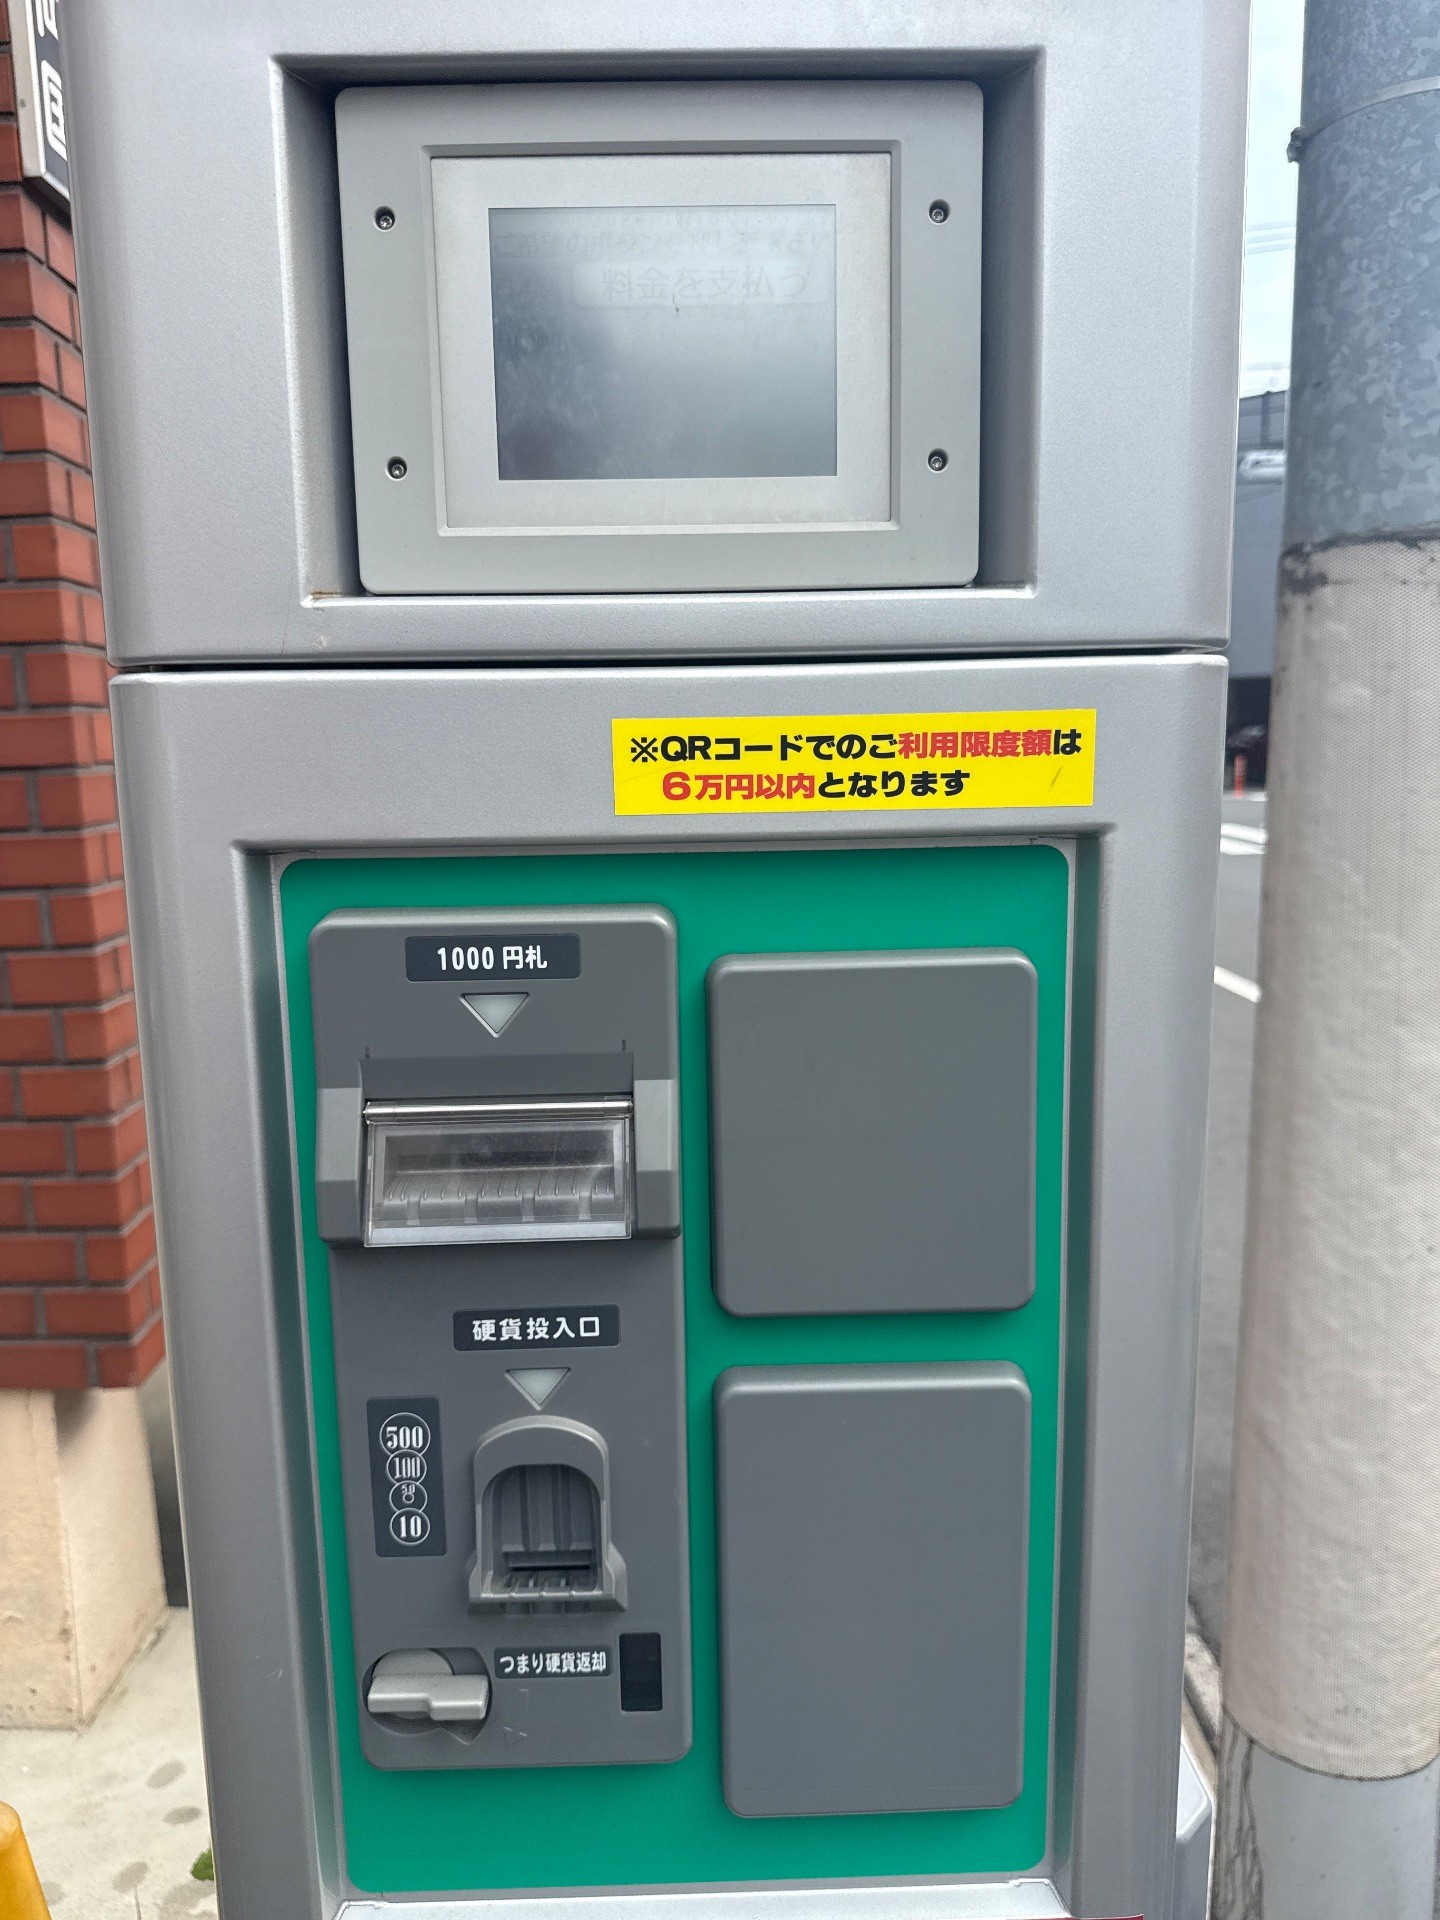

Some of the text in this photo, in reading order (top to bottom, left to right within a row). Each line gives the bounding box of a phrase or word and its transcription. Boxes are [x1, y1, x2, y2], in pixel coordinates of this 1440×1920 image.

[662, 769, 971, 801] 6万円以内となります
[472, 1316, 600, 1342] 硬貨投入口
[386, 1425, 424, 1449] 500
[393, 1456, 421, 1479] 100
[399, 1514, 422, 1538] 10
[500, 1651, 607, 1675] つまり硬貨返却
